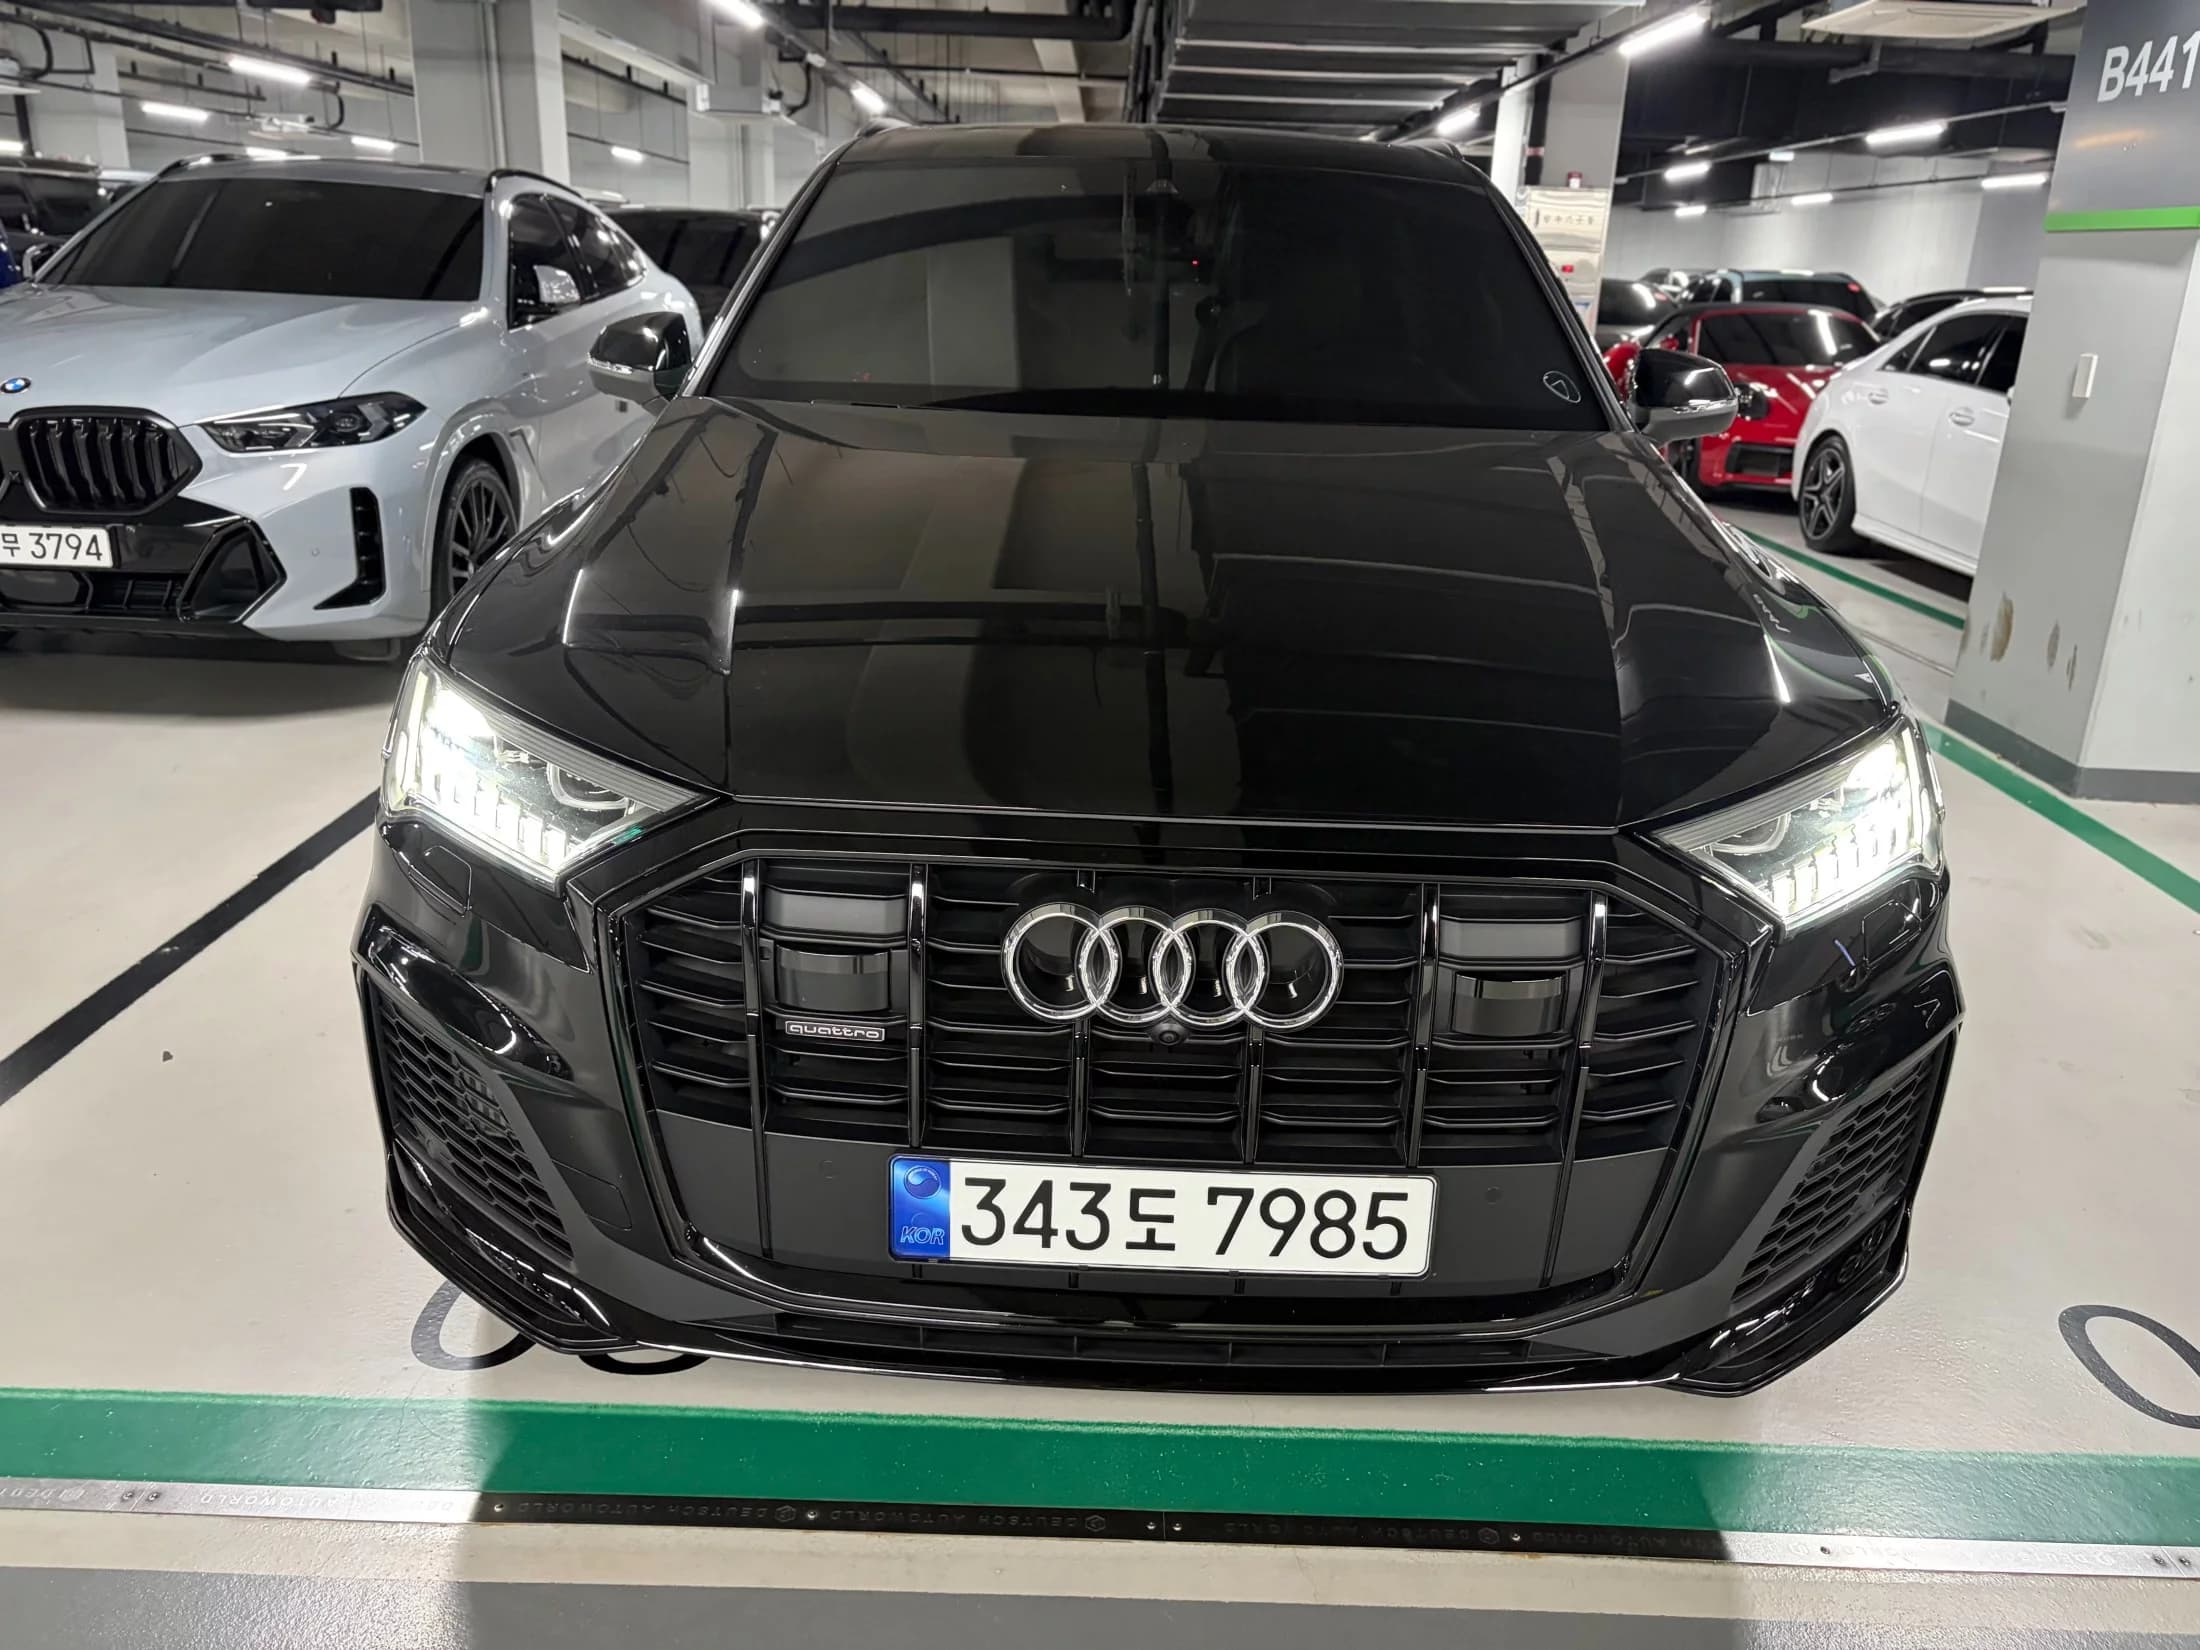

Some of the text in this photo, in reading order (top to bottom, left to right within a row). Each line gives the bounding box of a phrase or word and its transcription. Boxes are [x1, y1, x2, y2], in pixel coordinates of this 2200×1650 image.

[2097, 30, 2200, 102] B441
[28, 532, 102, 561] 3794
[789, 1024, 880, 1039] quattro
[961, 1177, 1409, 1260] 343도 7985
[900, 1225, 945, 1245] KOR
[200, 1494, 336, 1507] AUTOWORLD
[519, 1502, 768, 1519] DEUTSCH AUTOWORLD
[830, 1510, 1078, 1528] DEUTSCH AUTOWORLD
